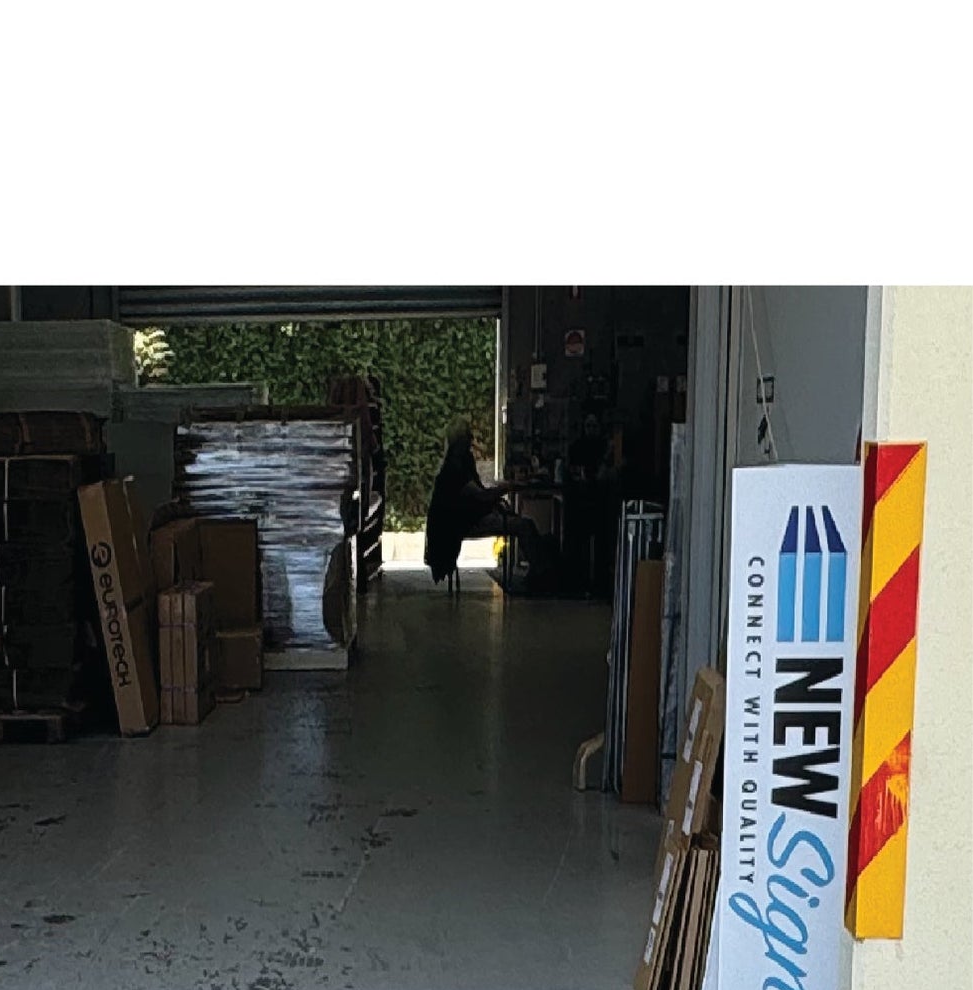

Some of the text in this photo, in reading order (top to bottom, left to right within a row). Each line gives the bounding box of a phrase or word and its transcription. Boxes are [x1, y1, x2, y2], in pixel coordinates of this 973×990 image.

[739, 556, 765, 884] CONNECT WITH QUALITY
[770, 657, 844, 819] NEW
